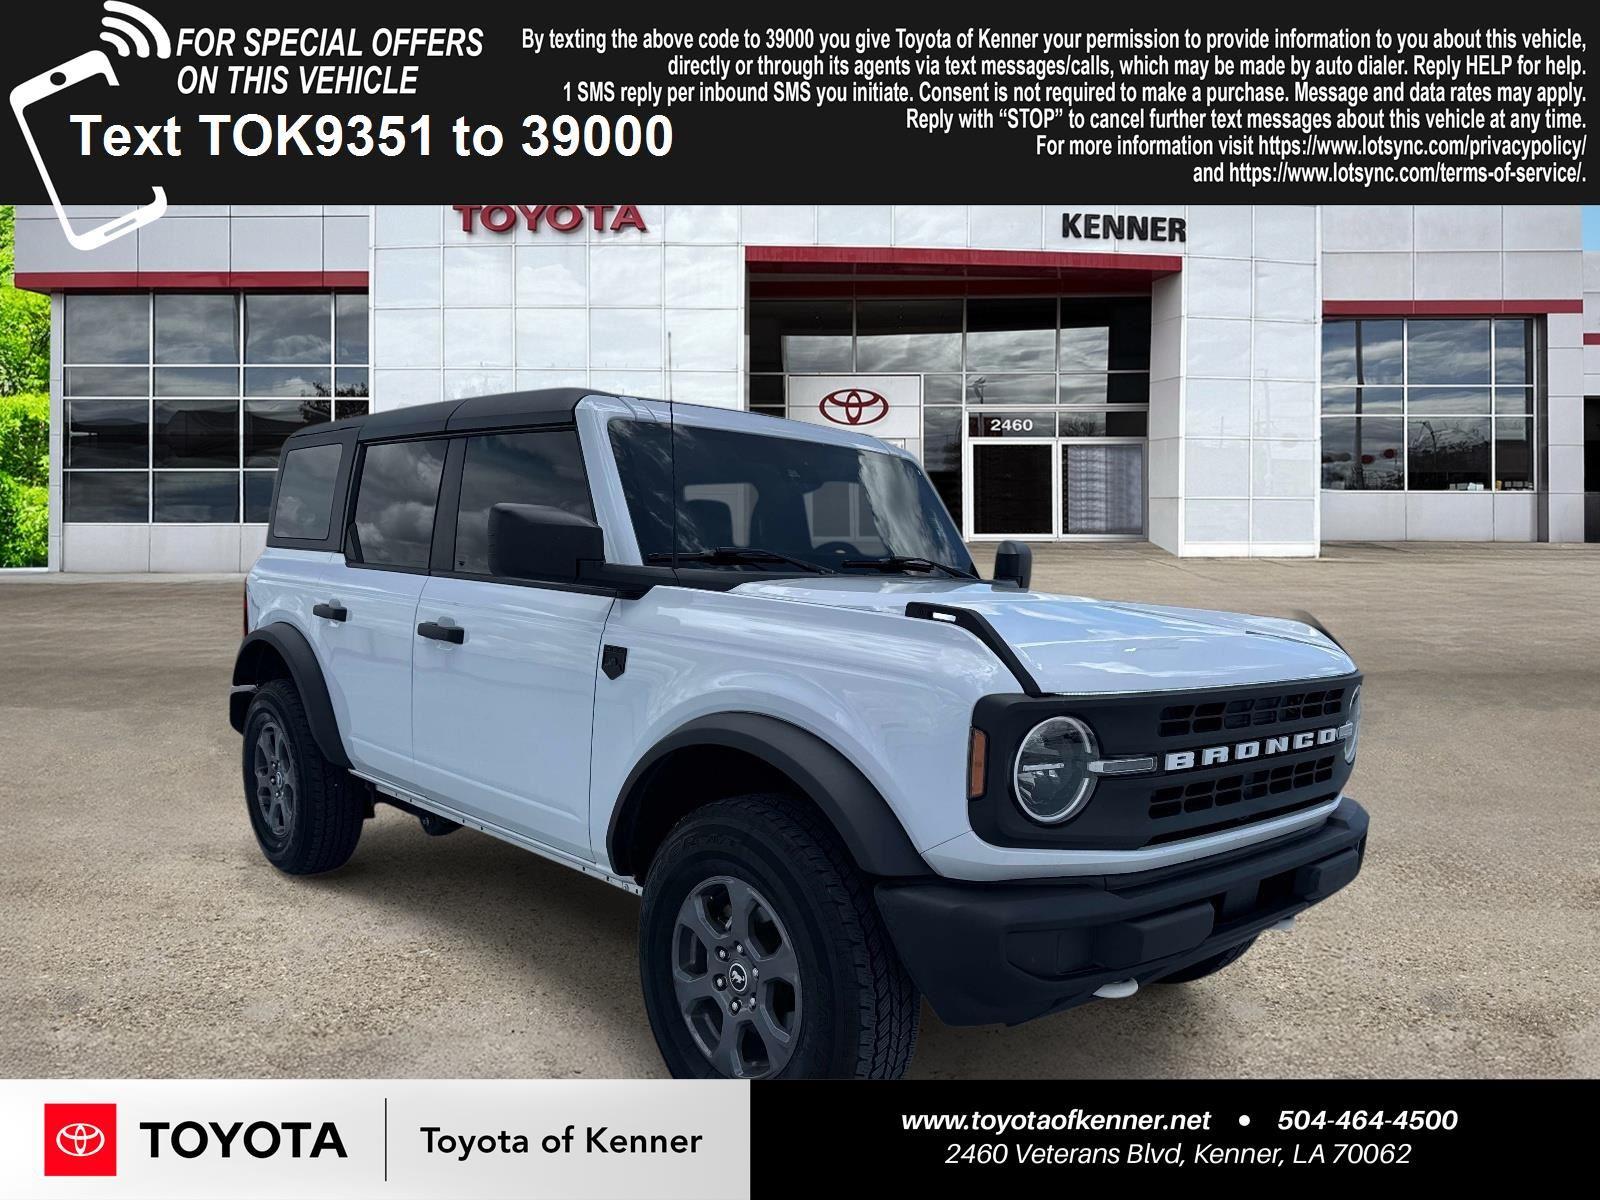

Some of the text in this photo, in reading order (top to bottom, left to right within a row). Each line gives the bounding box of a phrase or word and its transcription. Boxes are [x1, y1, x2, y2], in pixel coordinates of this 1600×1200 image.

[452, 204, 647, 233] TOYOTA
[1061, 212, 1187, 243] KENNER
[990, 418, 1034, 432] 2460
[1164, 727, 1337, 772] BRONCO
